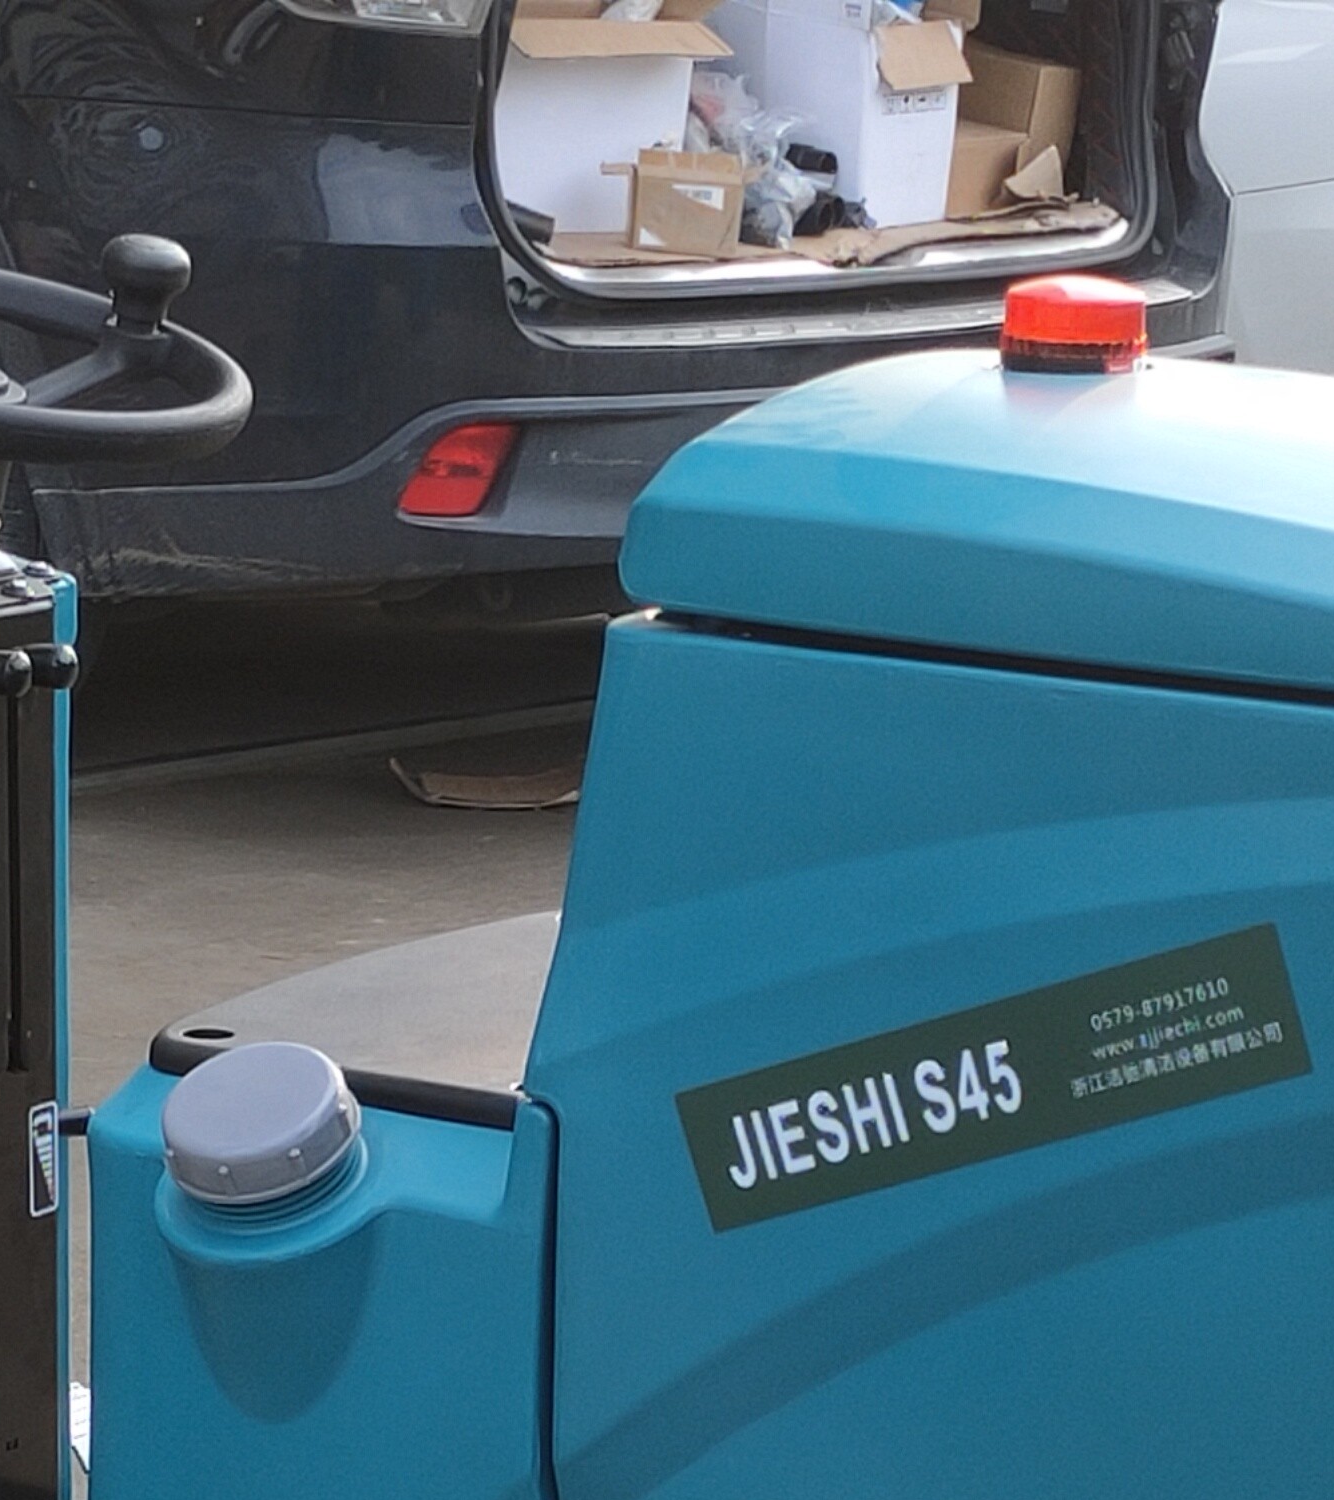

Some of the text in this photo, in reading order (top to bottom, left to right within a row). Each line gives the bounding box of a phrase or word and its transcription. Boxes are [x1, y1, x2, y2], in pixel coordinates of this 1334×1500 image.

[1089, 976, 1230, 1033] 0579-87917610
[728, 1038, 1023, 1190] JIESHI S45
